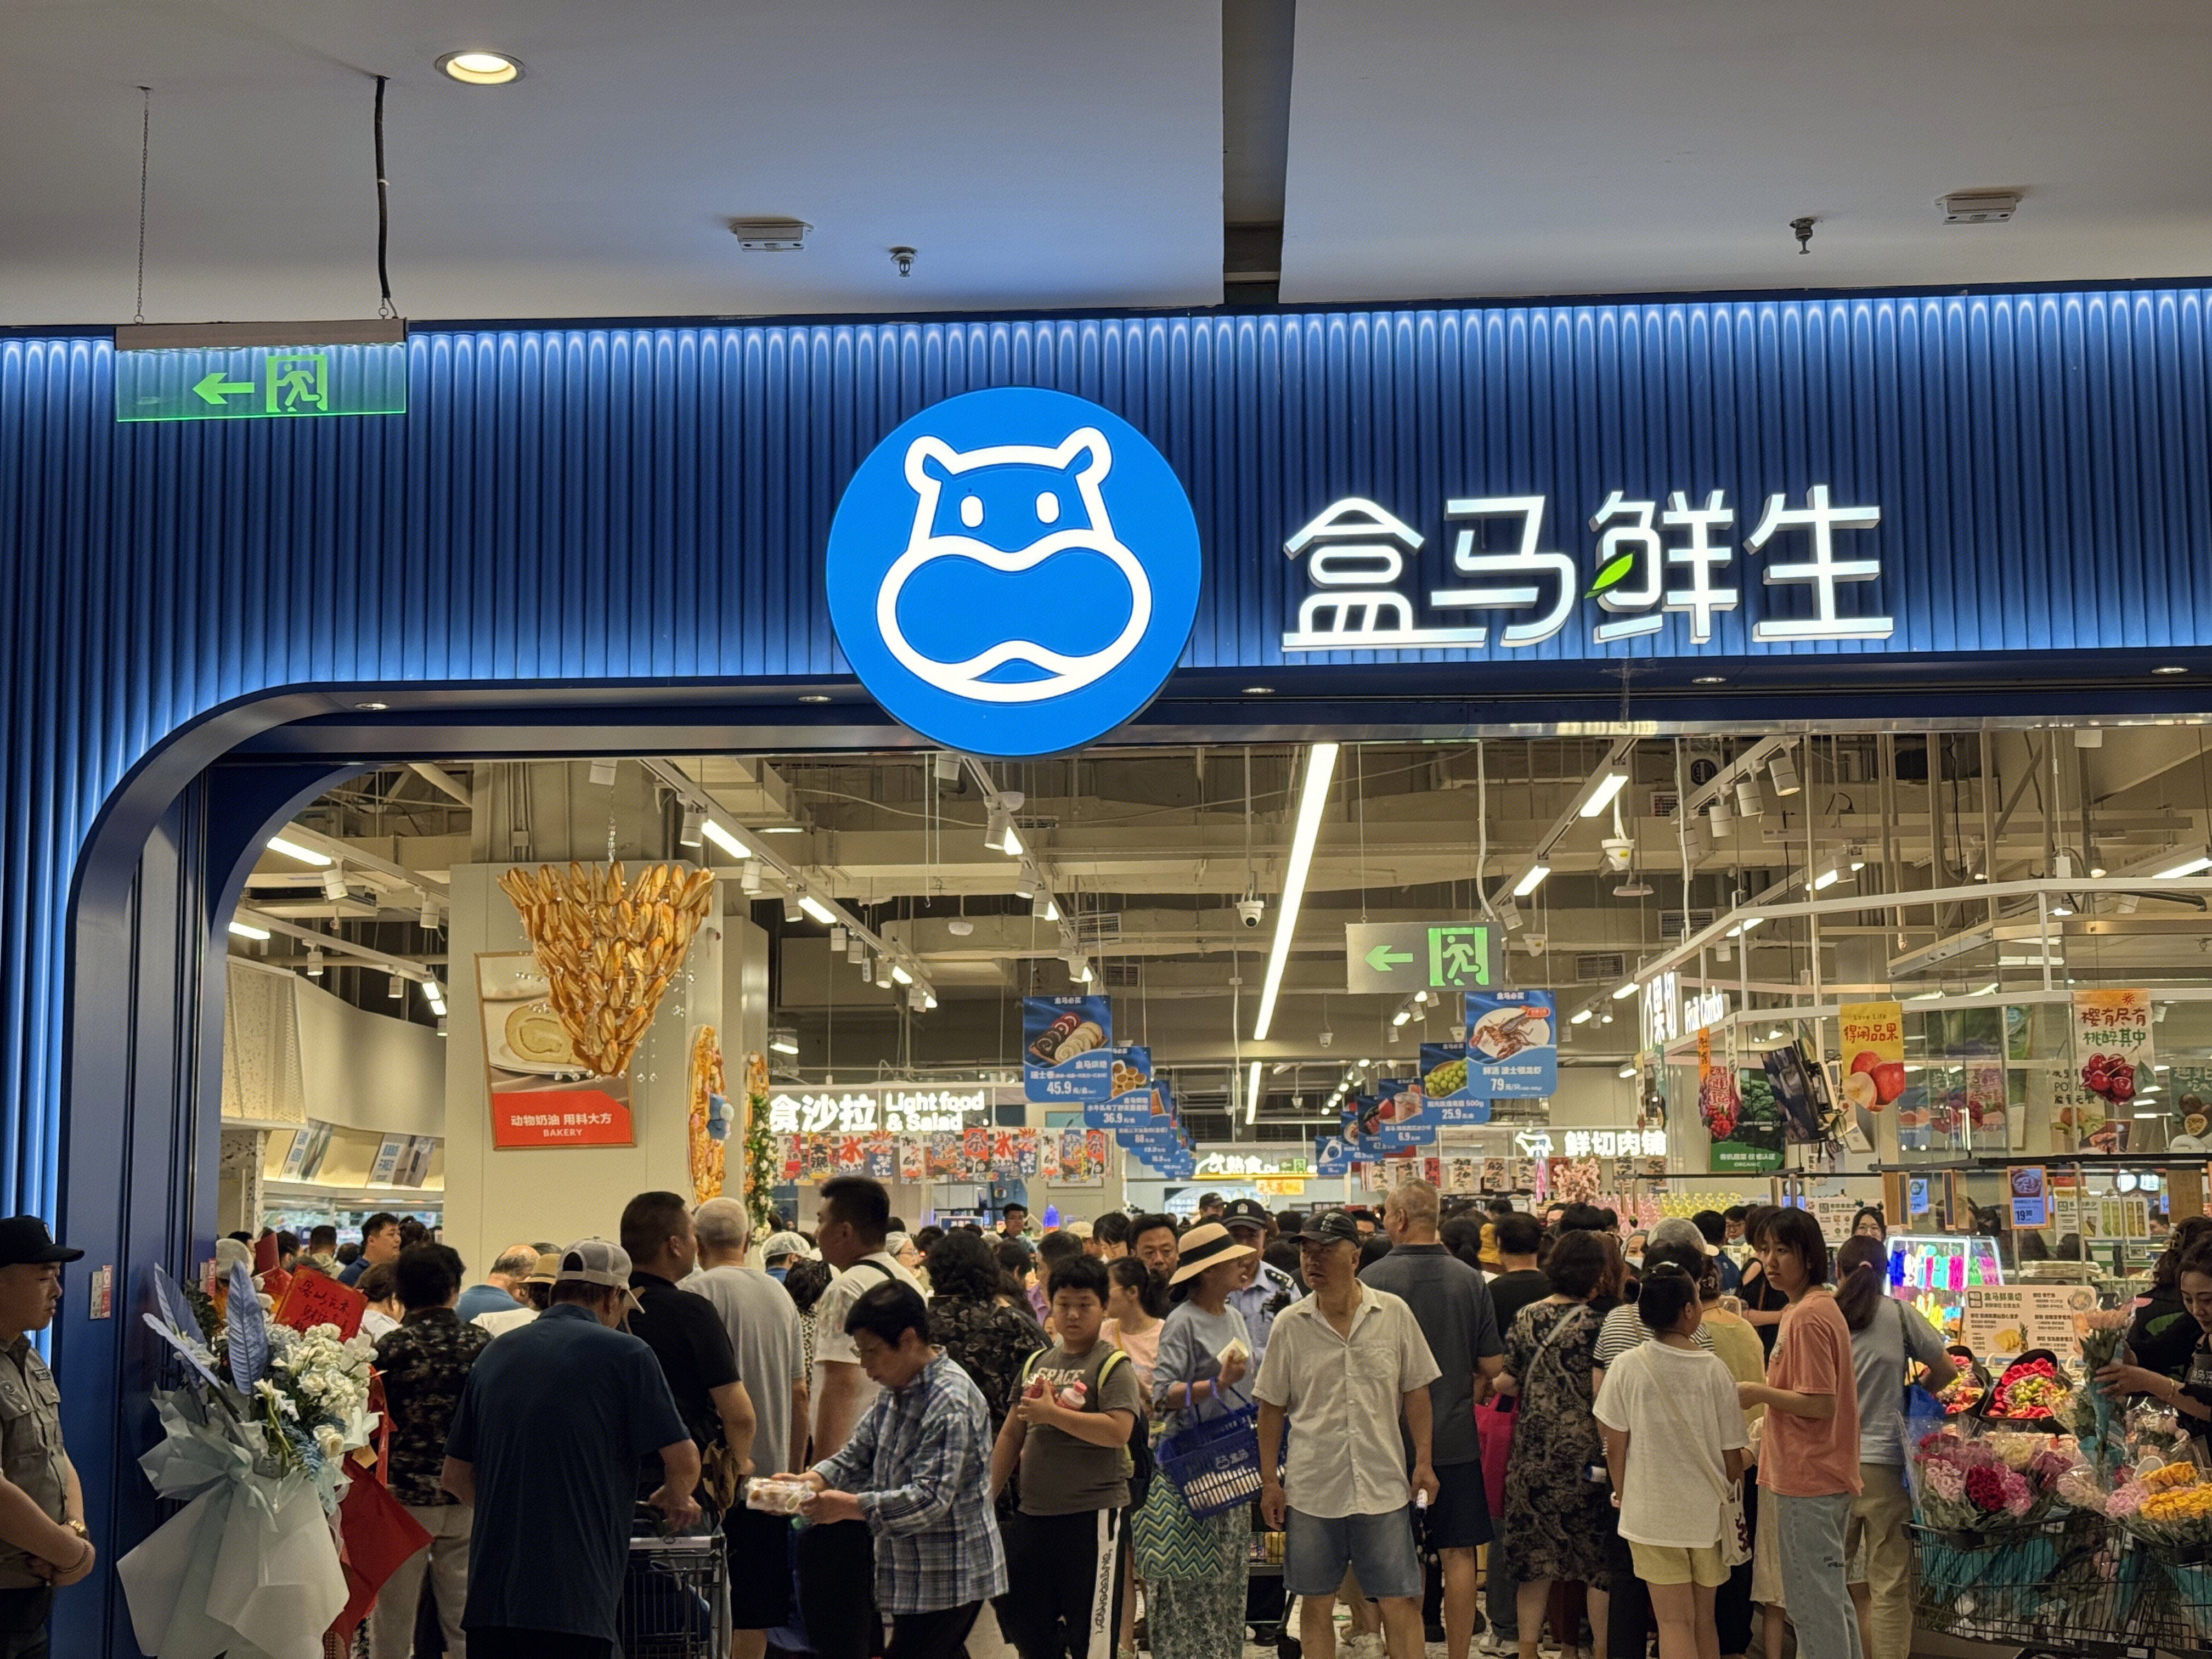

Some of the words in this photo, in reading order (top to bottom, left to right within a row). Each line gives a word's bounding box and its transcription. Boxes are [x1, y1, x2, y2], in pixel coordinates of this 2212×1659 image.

[1282, 484, 1894, 652] 盒马鲜生
[2081, 1008, 2146, 1027] 樱有尽有
[1843, 1023, 1899, 1044] 得闲品果
[2083, 1027, 2146, 1047] 桃醉其中
[1501, 1066, 1542, 1075] 波士顿龙虾
[1047, 1081, 1072, 1095] 45.9
[1491, 1079, 1504, 1091] 79
[886, 1091, 937, 1114] Light
[940, 1091, 985, 1111] food
[510, 1114, 560, 1126] 动物奶油
[563, 1113, 612, 1125] 用料大方
[770, 1094, 878, 1132] 食沙拉
[1103, 1113, 1123, 1124] 36.9
[1442, 1108, 1462, 1120] 25.9
[886, 1113, 904, 1132] &
[906, 1113, 963, 1132] Salad
[543, 1128, 583, 1137] BAKERY
[1398, 1132, 1410, 1141] 6.9
[1564, 1130, 1667, 1157] 鲜切肉铺
[2015, 1210, 2025, 1221] 19
